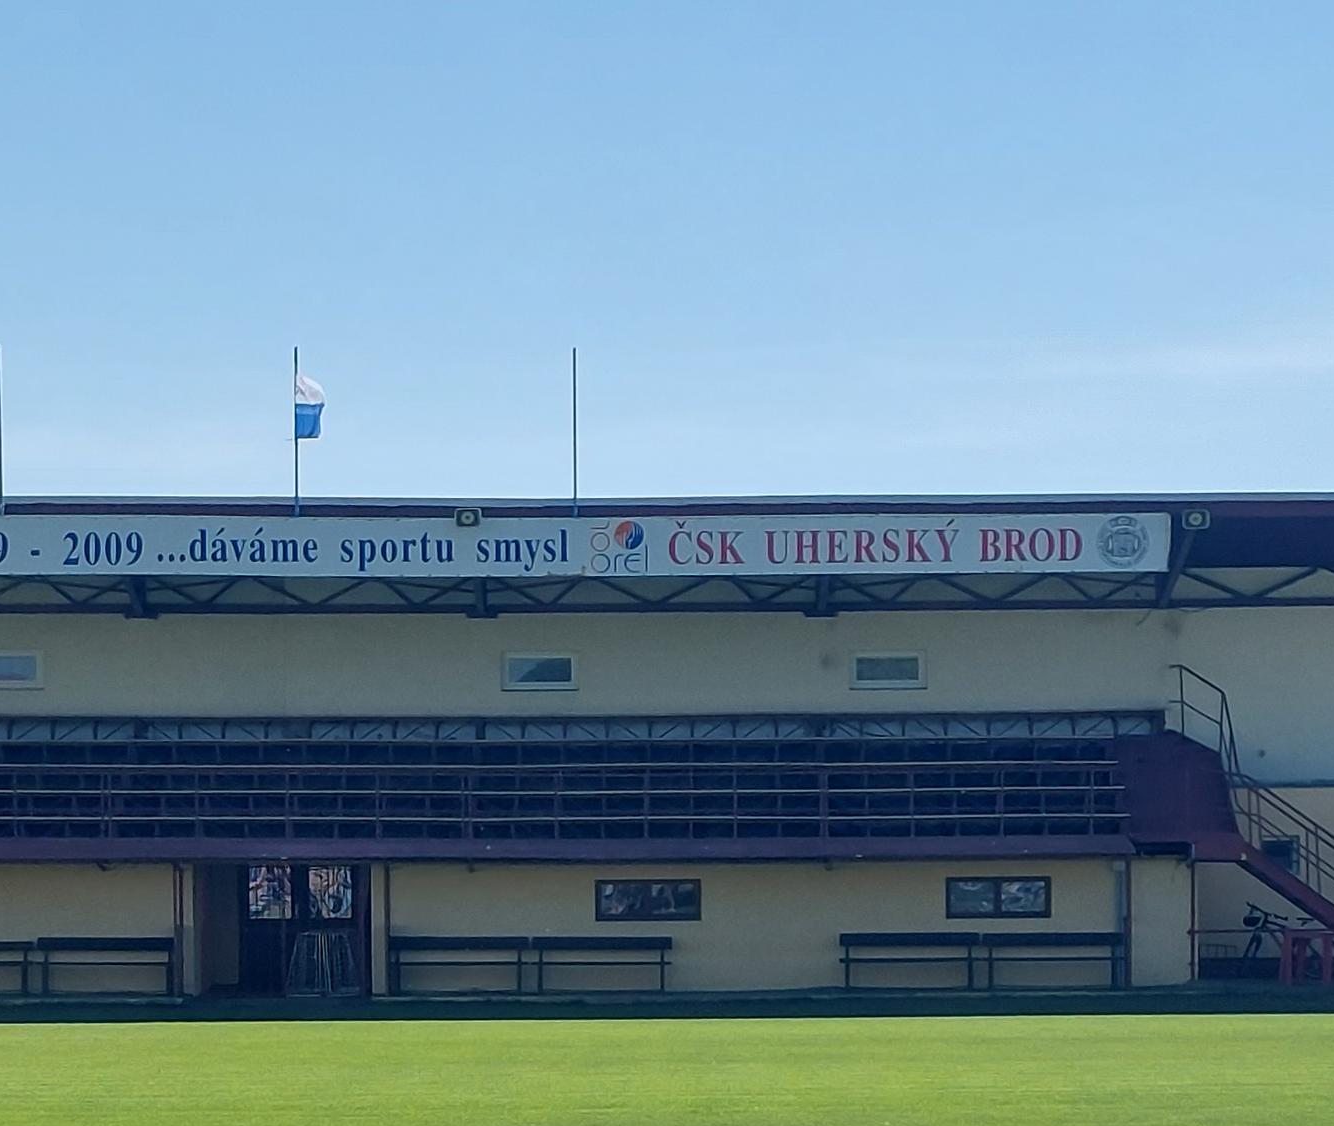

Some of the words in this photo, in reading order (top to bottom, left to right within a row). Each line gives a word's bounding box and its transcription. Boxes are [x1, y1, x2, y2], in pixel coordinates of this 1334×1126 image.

[62, 531, 143, 566] 2009
[340, 532, 454, 571] sportu
[476, 529, 569, 571] smysl
[668, 520, 745, 565] ČSK
[765, 518, 960, 564] UHERSKÝ
[979, 528, 1083, 562] BROD
